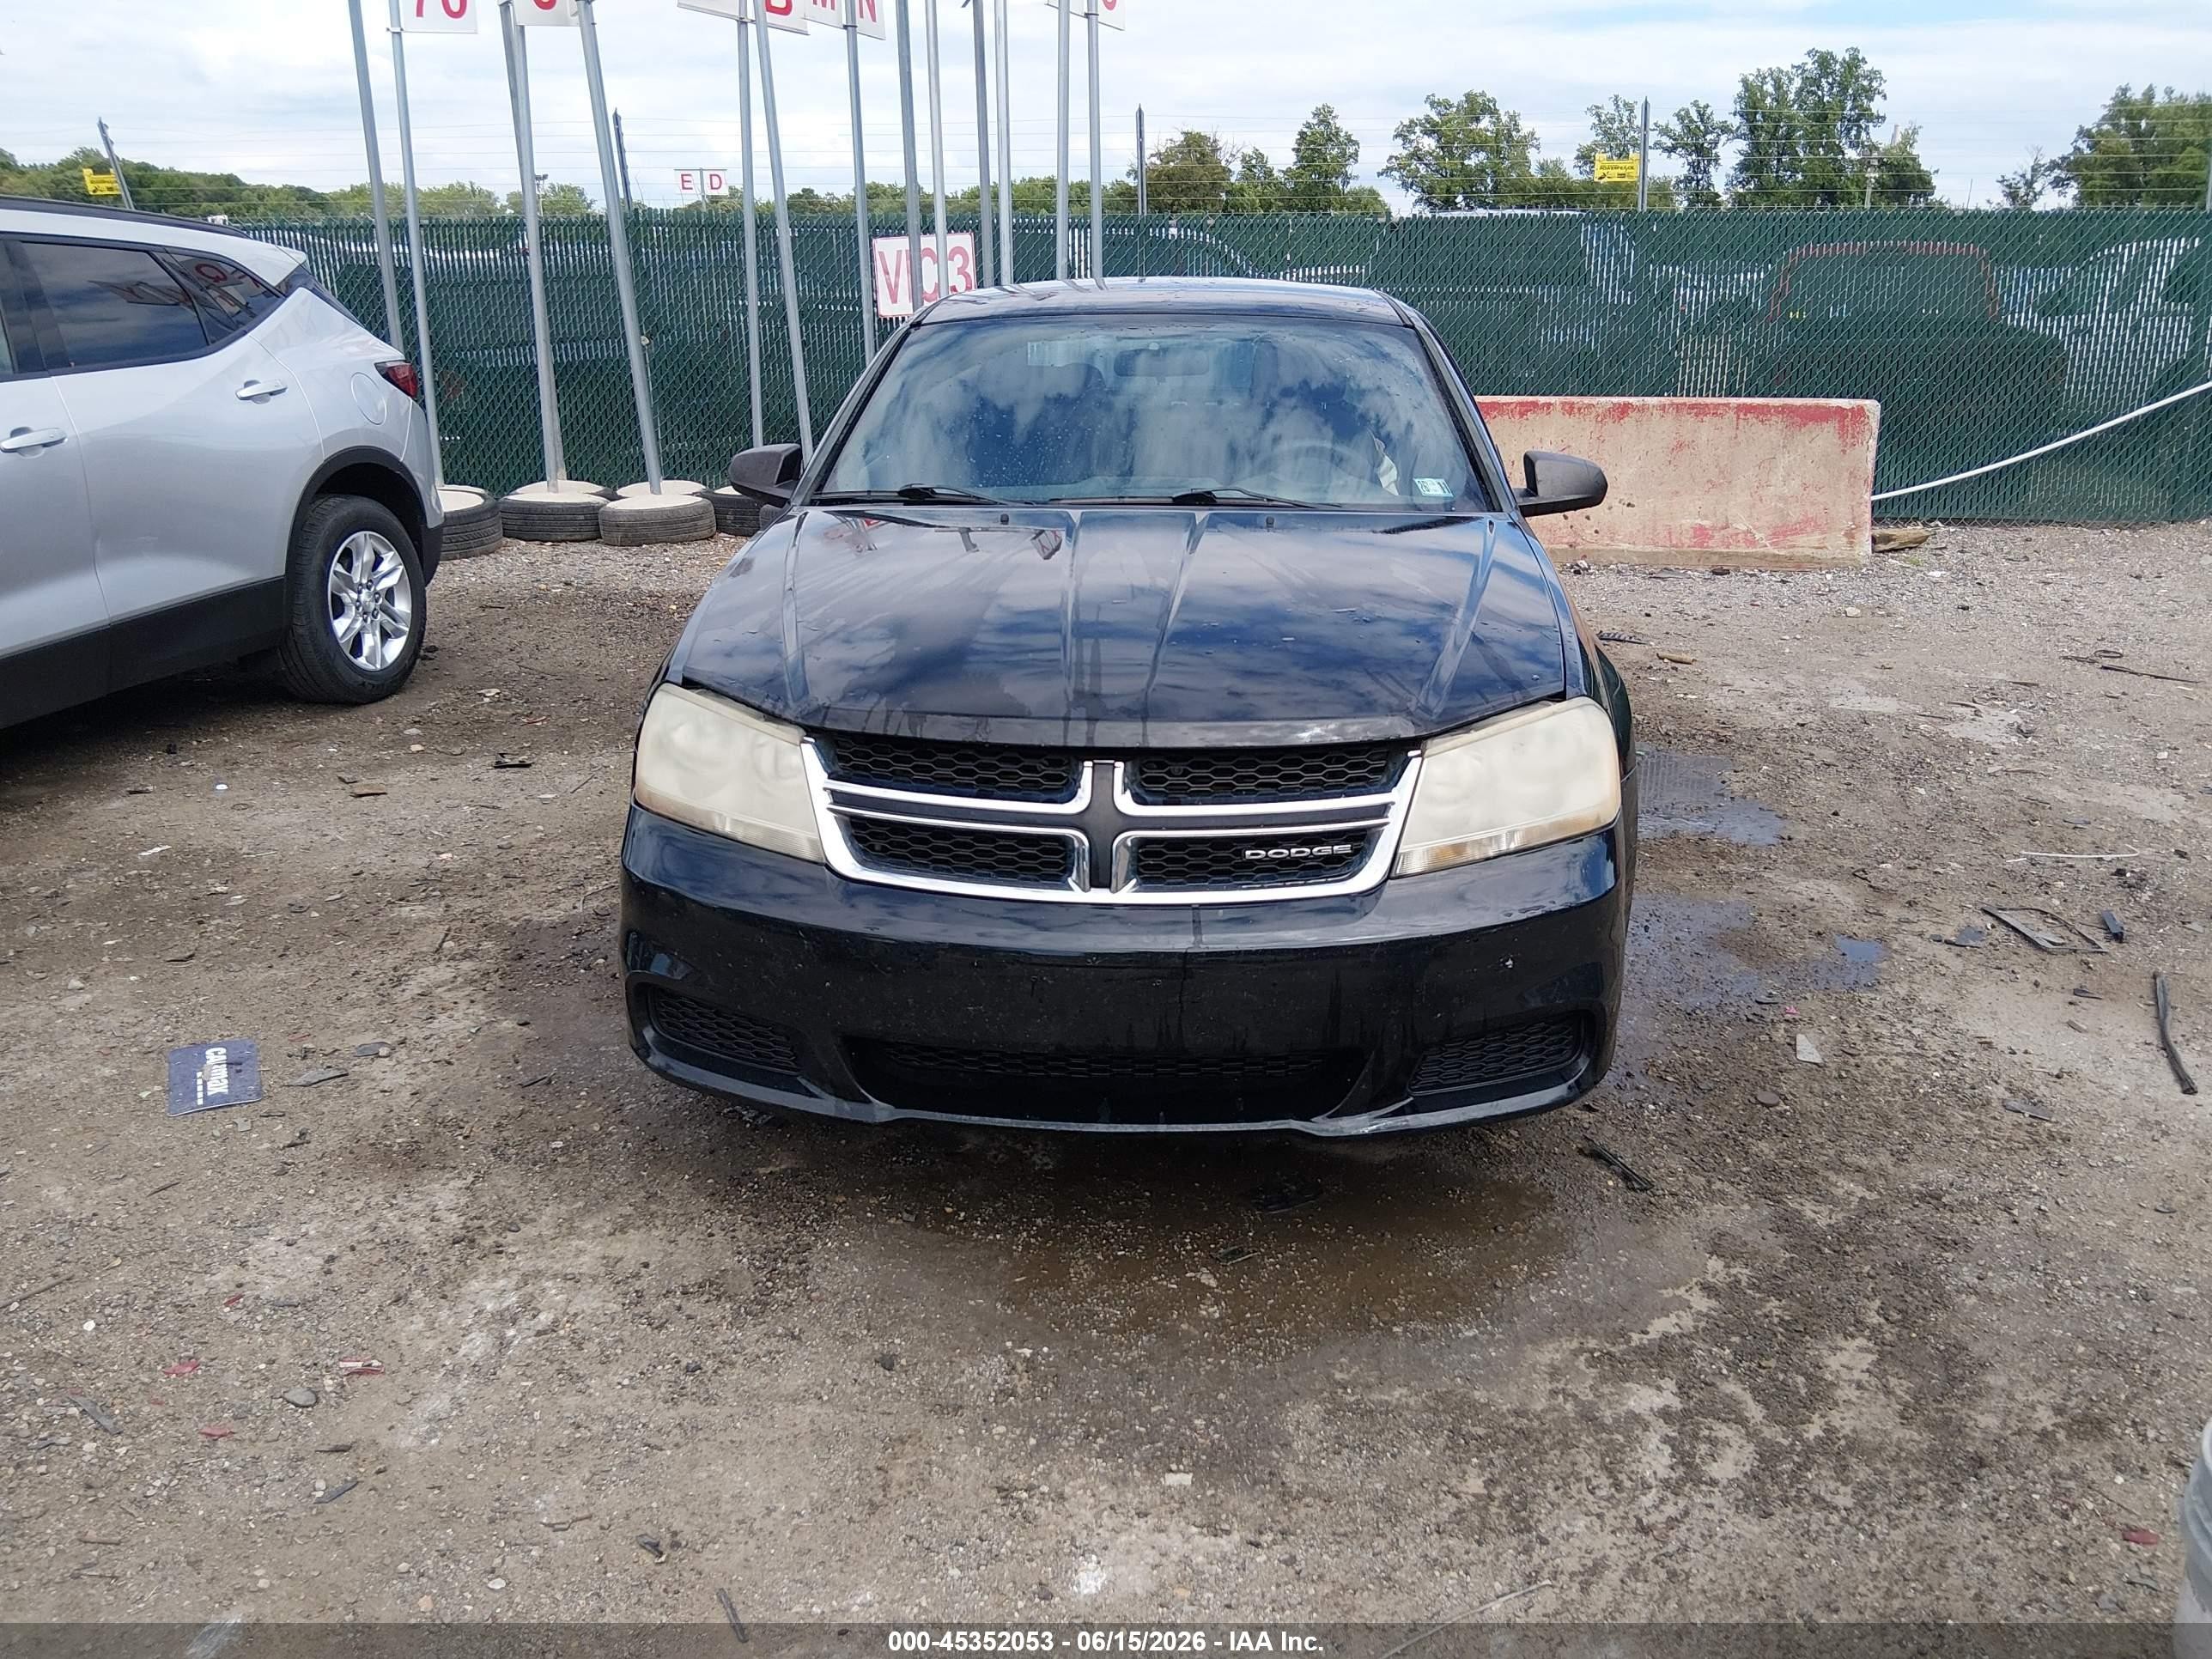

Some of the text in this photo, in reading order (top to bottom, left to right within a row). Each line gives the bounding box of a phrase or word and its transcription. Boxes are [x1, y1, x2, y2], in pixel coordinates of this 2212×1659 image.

[681, 173, 693, 190] E
[709, 173, 722, 190] D
[1245, 844, 1352, 859] DODGE
